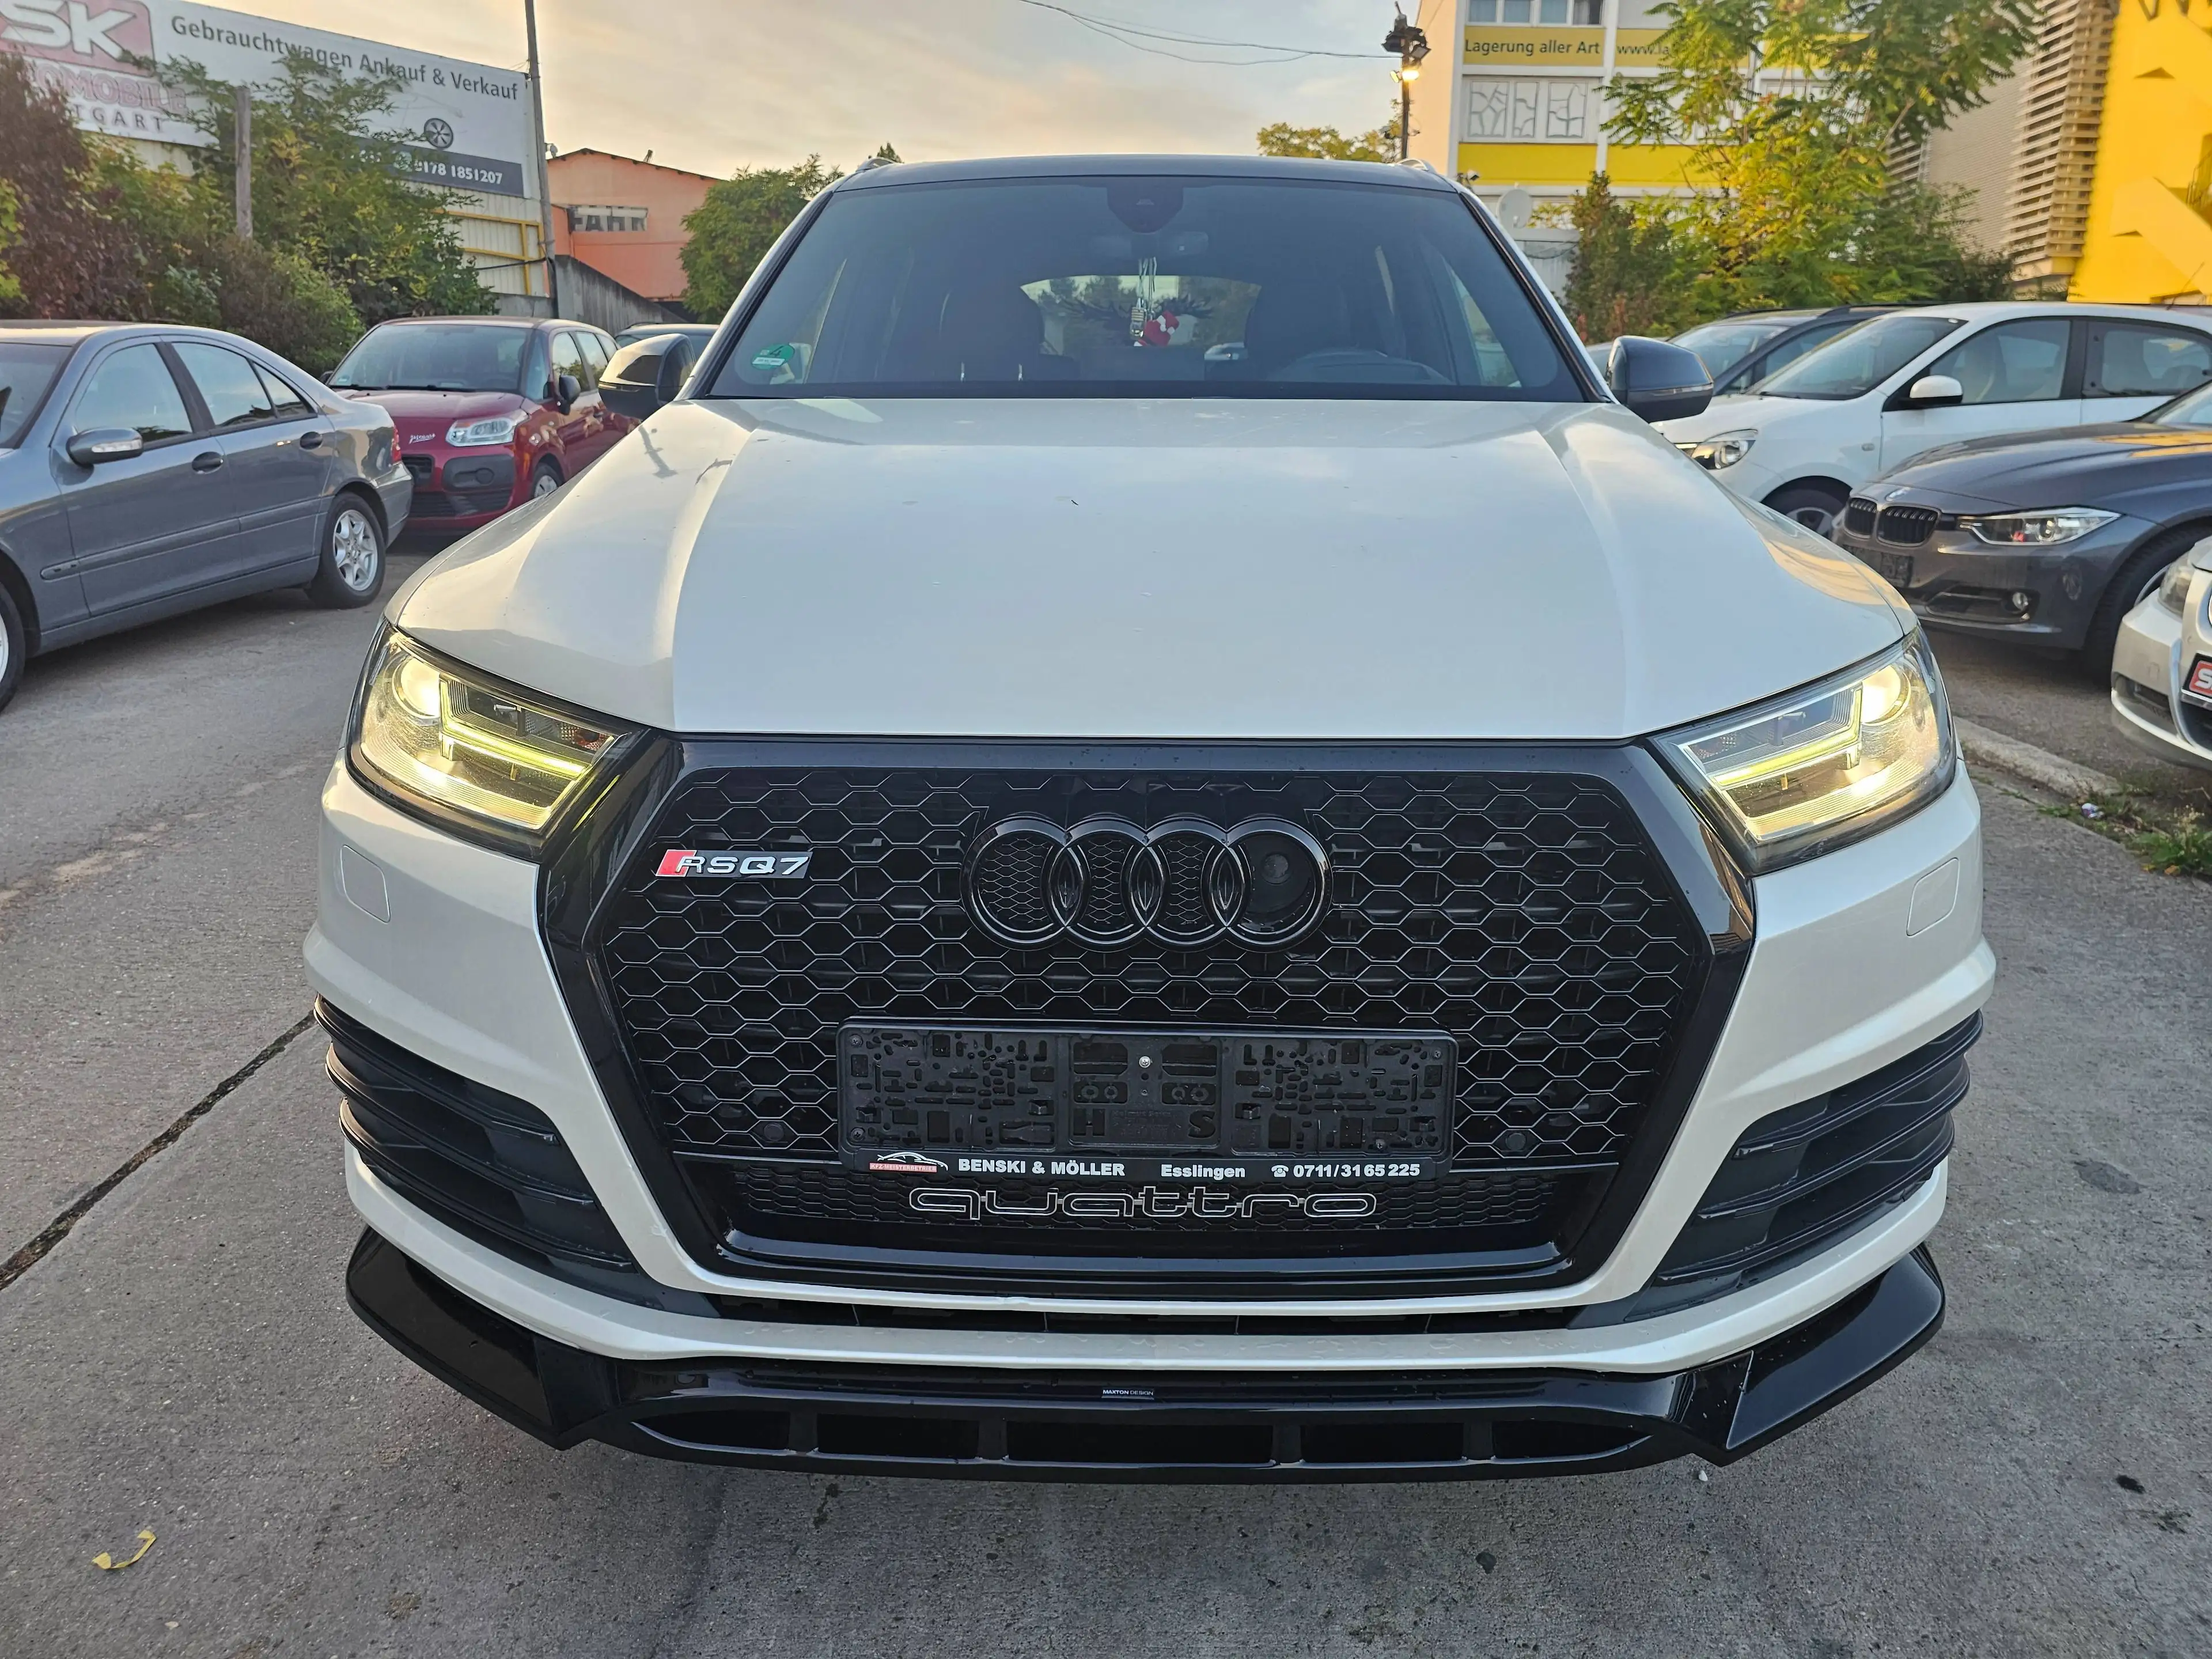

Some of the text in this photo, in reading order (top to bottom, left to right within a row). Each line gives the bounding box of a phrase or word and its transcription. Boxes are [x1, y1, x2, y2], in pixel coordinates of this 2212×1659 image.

[171, 15, 518, 100] Gebrauchtwagen Ankauf & Verkauf
[1464, 39, 1671, 56] Lagerung aller Art www.la
[36, 62, 188, 115] OMOBILE
[73, 104, 162, 132] TGART
[451, 165, 502, 184] 1851207
[2194, 668, 2212, 690] S
[675, 856, 809, 876] RSQ7
[959, 1158, 1026, 1173] BENSKI
[1032, 1161, 1046, 1174] &
[1051, 1160, 1125, 1176] MÖLLER
[1161, 1164, 1245, 1180] Esslingen
[909, 1185, 1376, 1221] quattro
